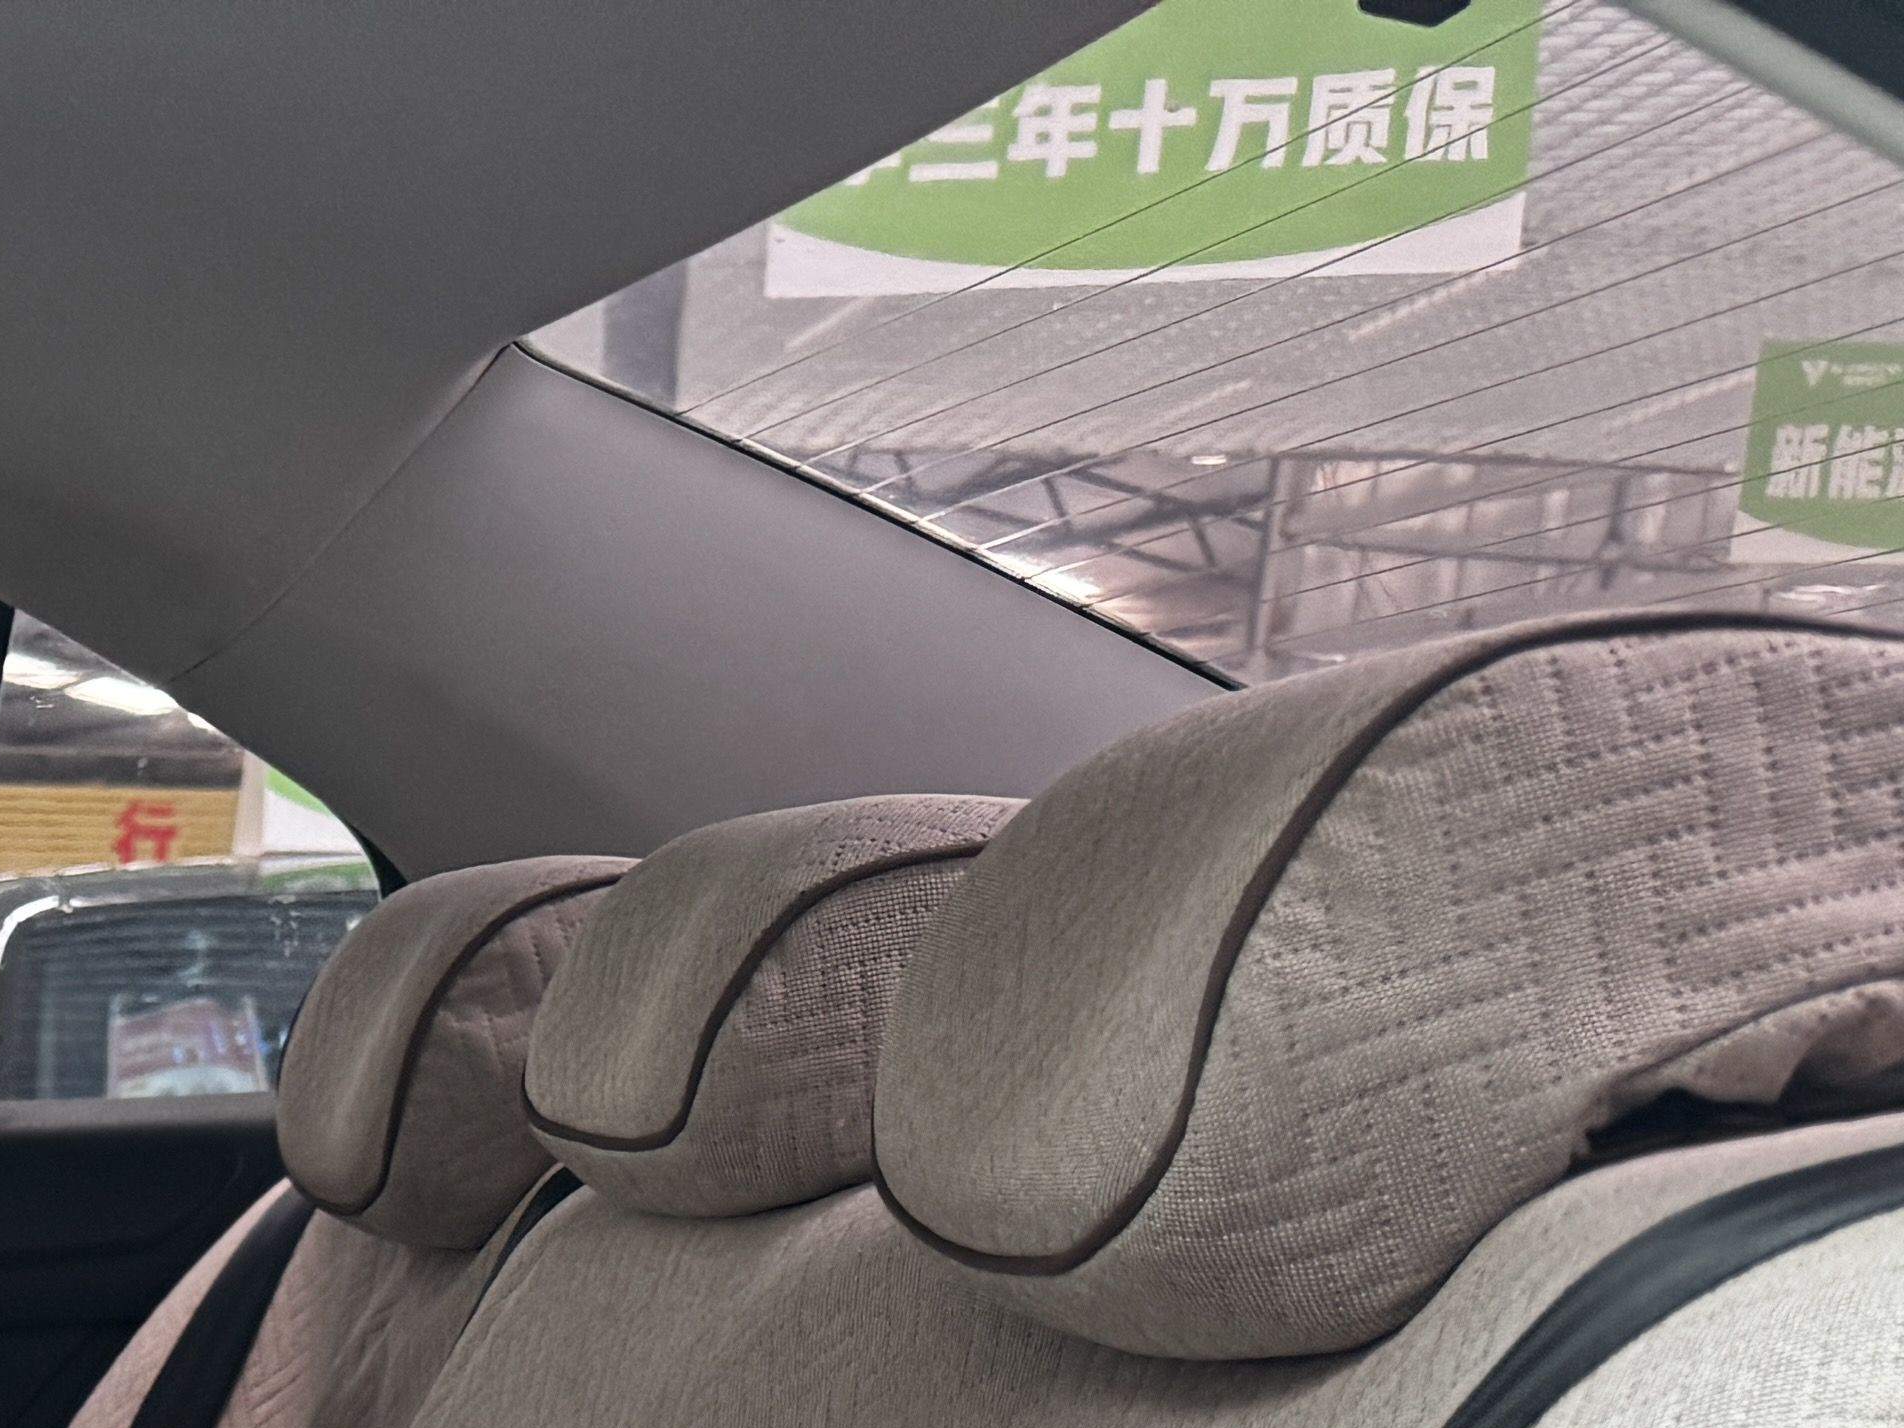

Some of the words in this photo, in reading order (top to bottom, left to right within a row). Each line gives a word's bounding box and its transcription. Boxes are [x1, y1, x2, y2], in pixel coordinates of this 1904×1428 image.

[848, 65, 1497, 186] 三年十万质保
[1765, 423, 1904, 500] 新能
